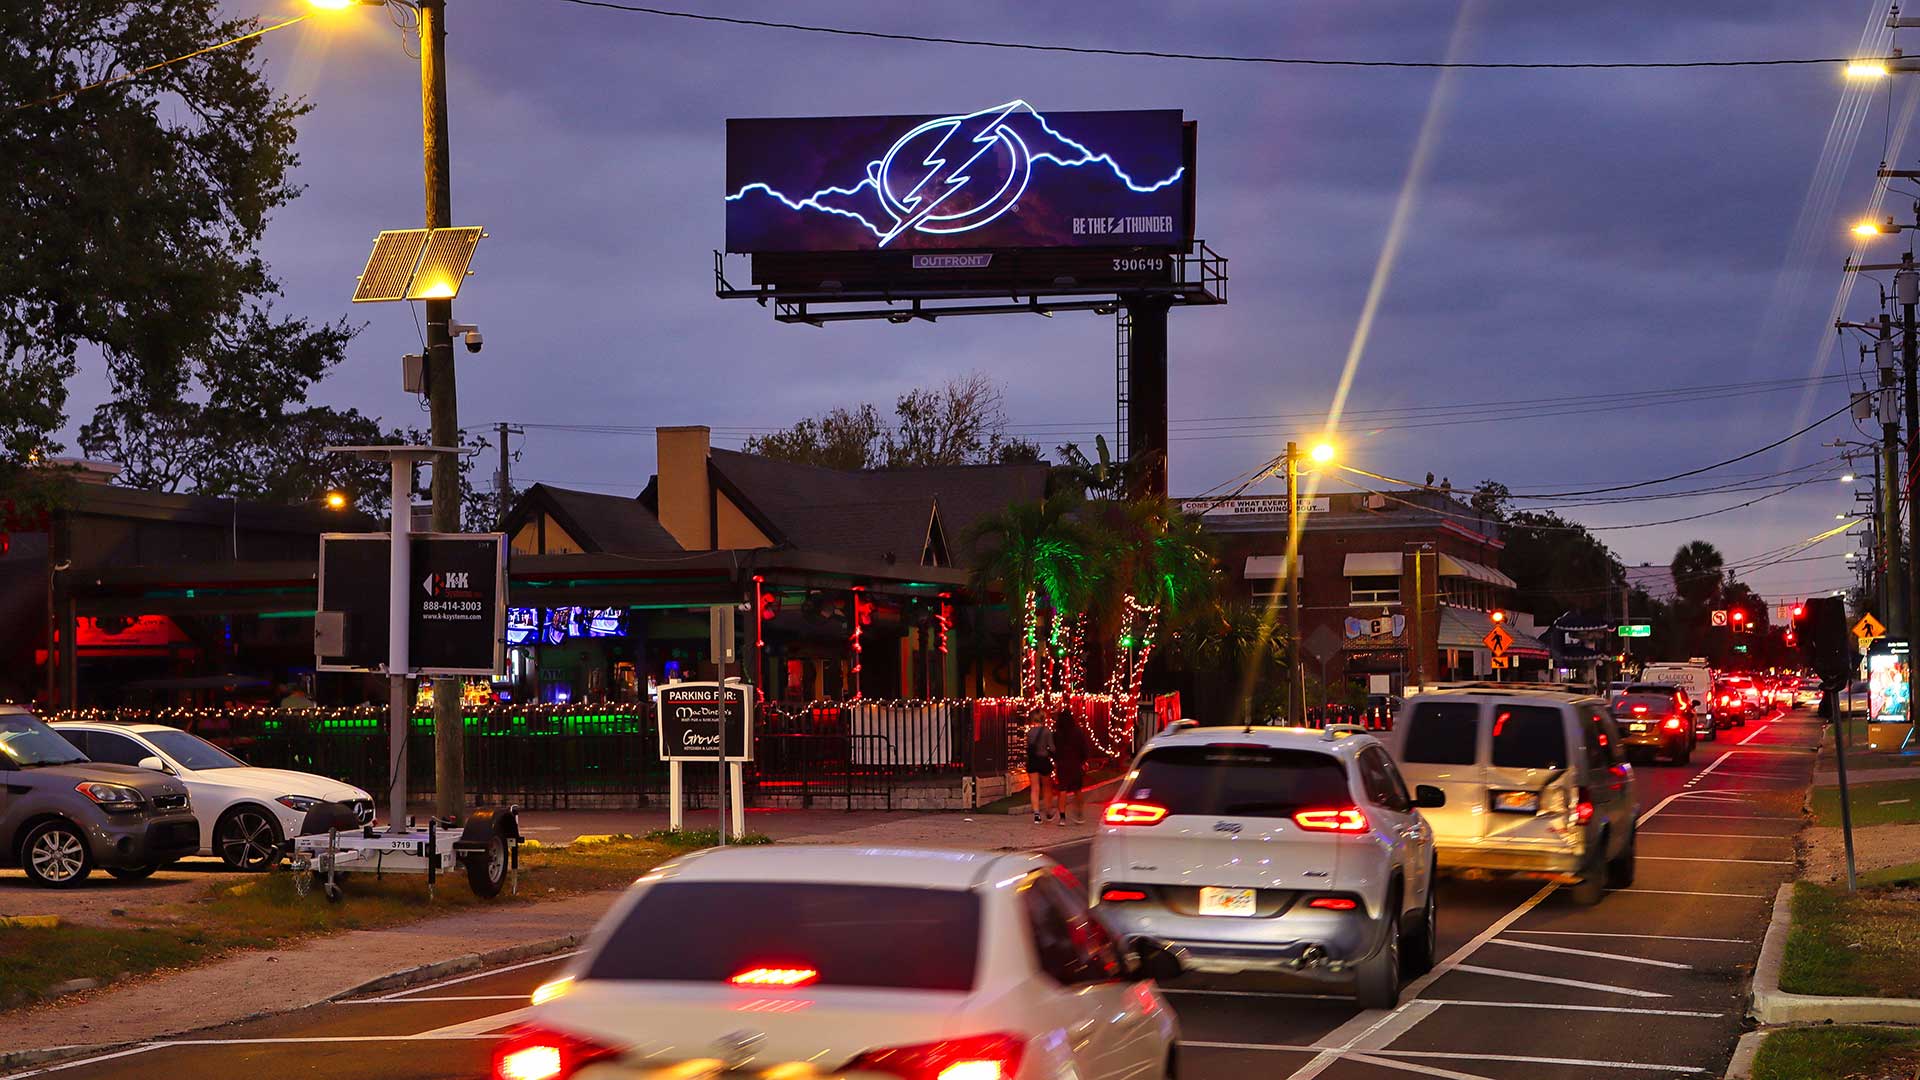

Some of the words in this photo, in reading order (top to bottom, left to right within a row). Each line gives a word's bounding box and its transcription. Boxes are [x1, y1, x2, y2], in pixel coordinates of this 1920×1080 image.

[1073, 217, 1086, 234] BE
[1088, 217, 1106, 234] THE
[1125, 216, 1173, 233] THUNDER
[920, 256, 983, 266] OUTFRONT
[1112, 258, 1164, 271] 390649
[445, 572, 469, 588] K&K
[423, 601, 482, 611] 888-414-3003
[422, 613, 482, 621] www.k-ksystems.com
[669, 691, 711, 700] PARKING
[683, 729, 720, 745] Grove
